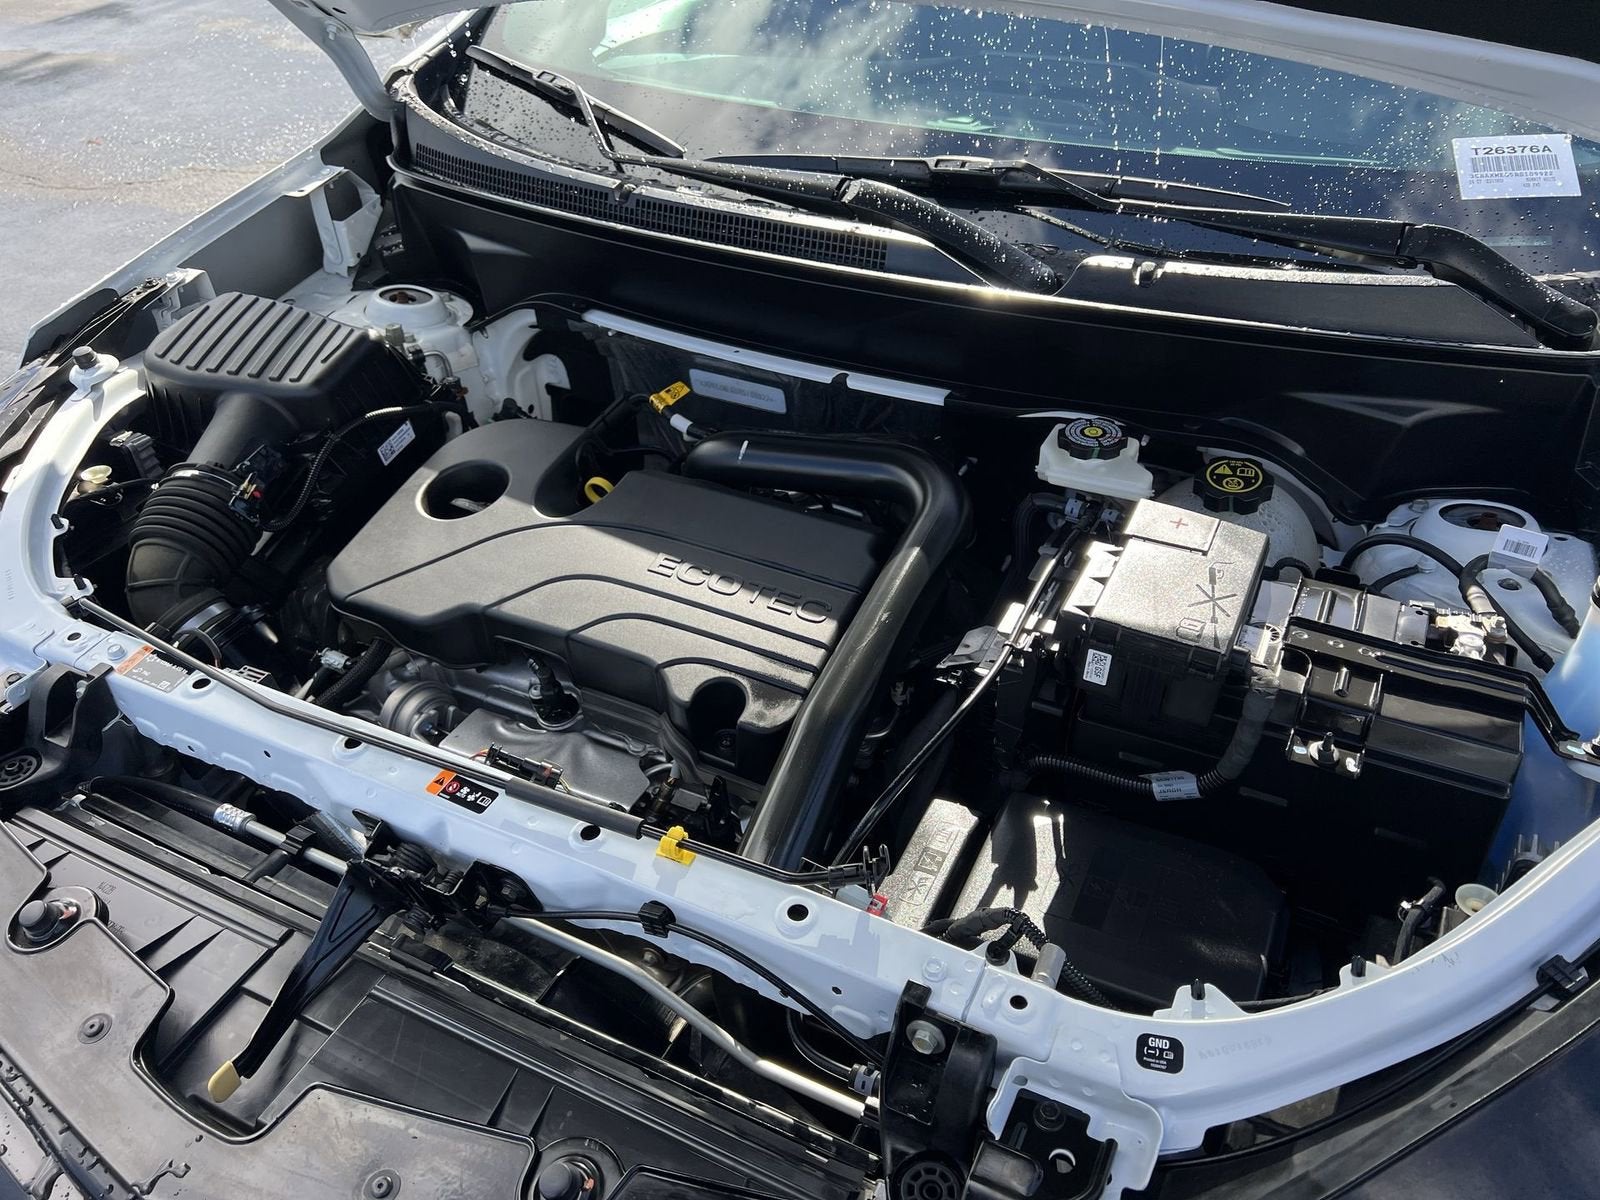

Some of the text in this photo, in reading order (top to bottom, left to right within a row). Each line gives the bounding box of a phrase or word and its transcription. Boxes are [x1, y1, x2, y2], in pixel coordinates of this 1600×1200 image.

[1471, 145, 1553, 156] T26376A
[647, 552, 833, 624] ECOTEC
[1148, 1037, 1169, 1049] GND
